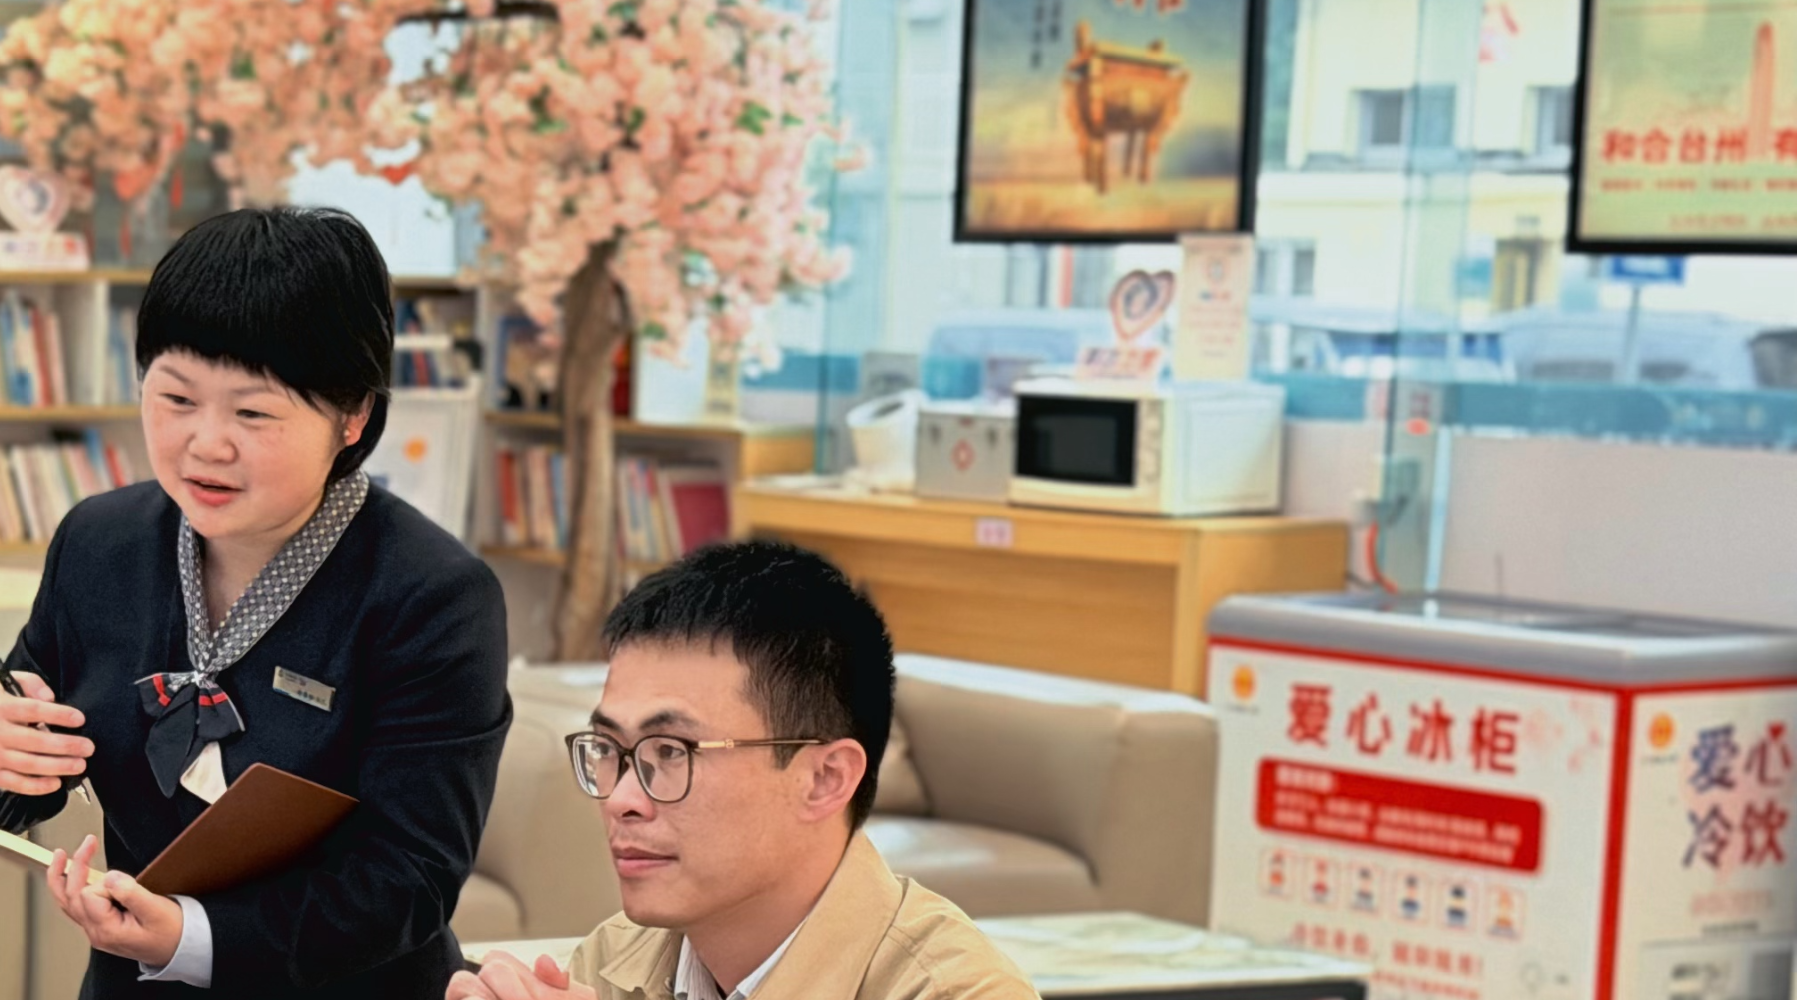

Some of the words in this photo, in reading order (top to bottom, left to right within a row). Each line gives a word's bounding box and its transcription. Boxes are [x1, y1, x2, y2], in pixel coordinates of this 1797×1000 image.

[1287, 682, 1522, 775] 爱心冰柜
[1688, 720, 1793, 795] 爱心
[1681, 801, 1788, 869] 冷饮
